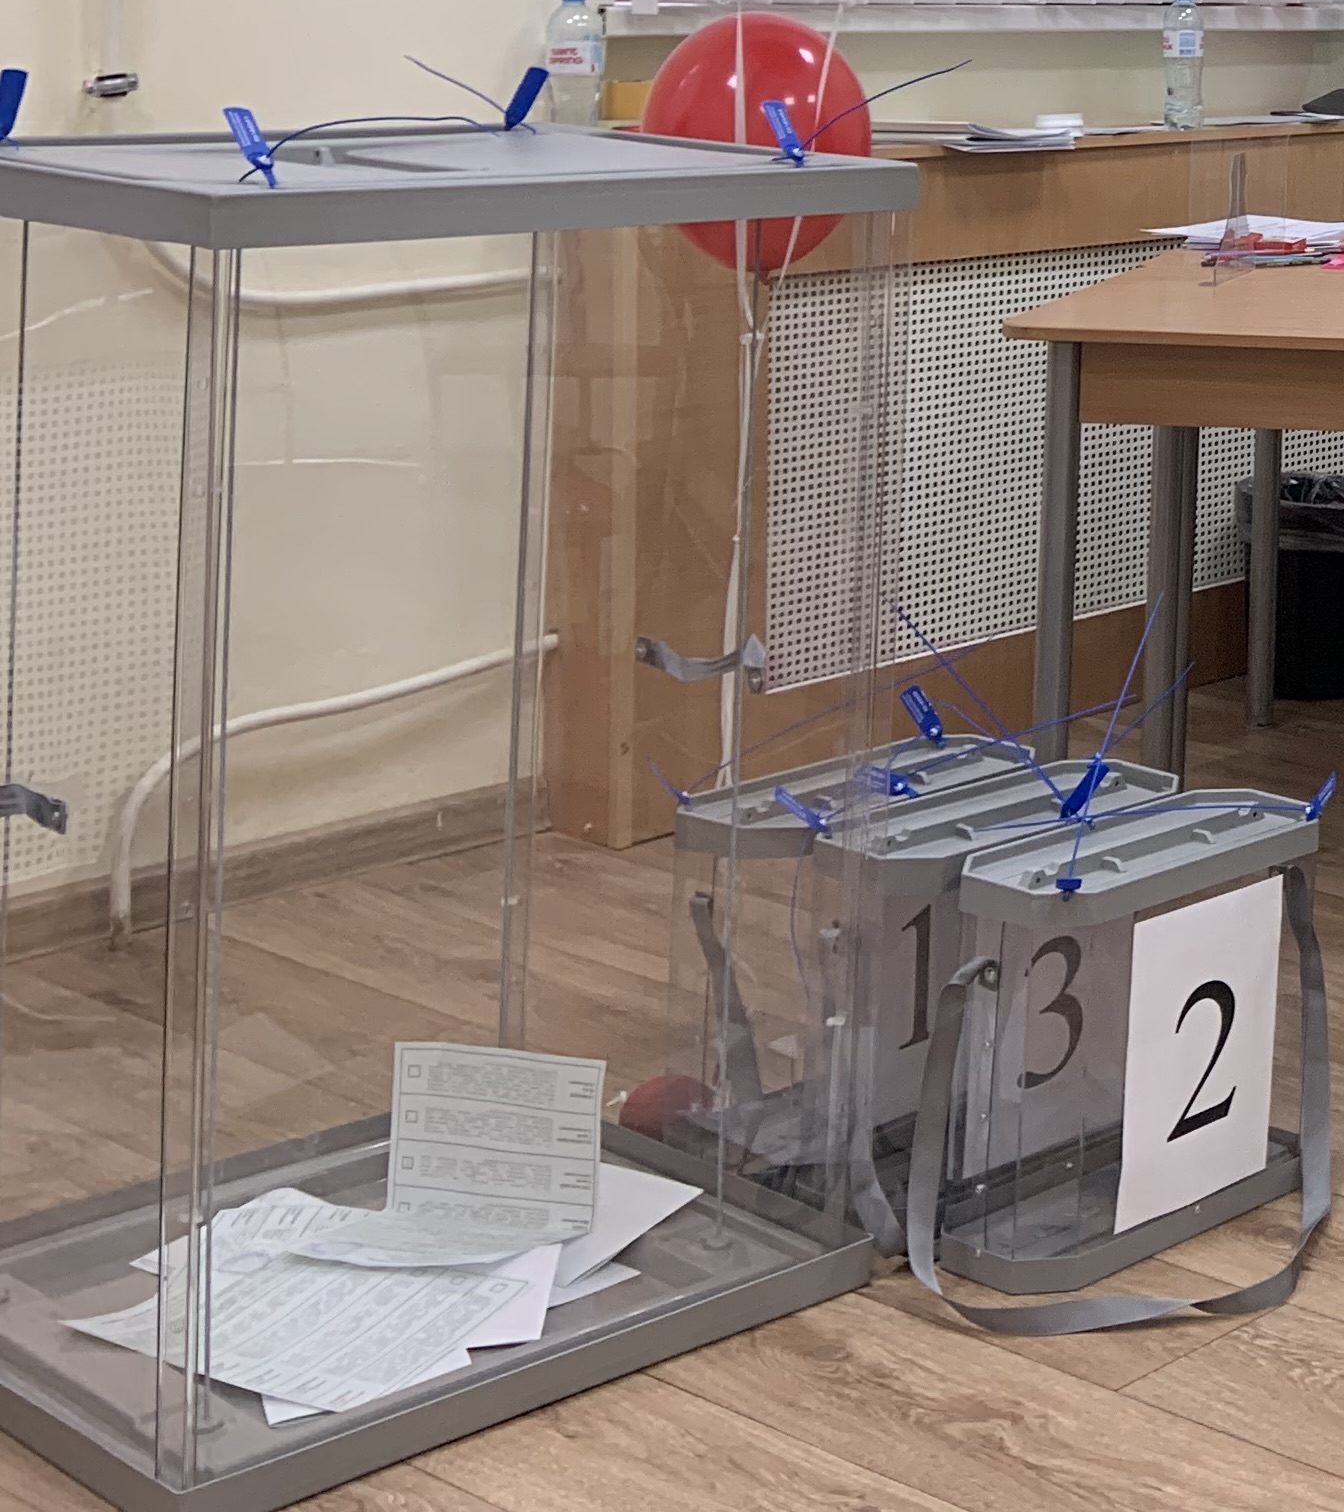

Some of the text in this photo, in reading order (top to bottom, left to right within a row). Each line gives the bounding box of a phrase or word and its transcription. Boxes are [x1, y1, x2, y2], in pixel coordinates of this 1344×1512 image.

[899, 904, 931, 1050] 1
[1017, 935, 1084, 1090] 3
[1166, 979, 1237, 1143] 2
